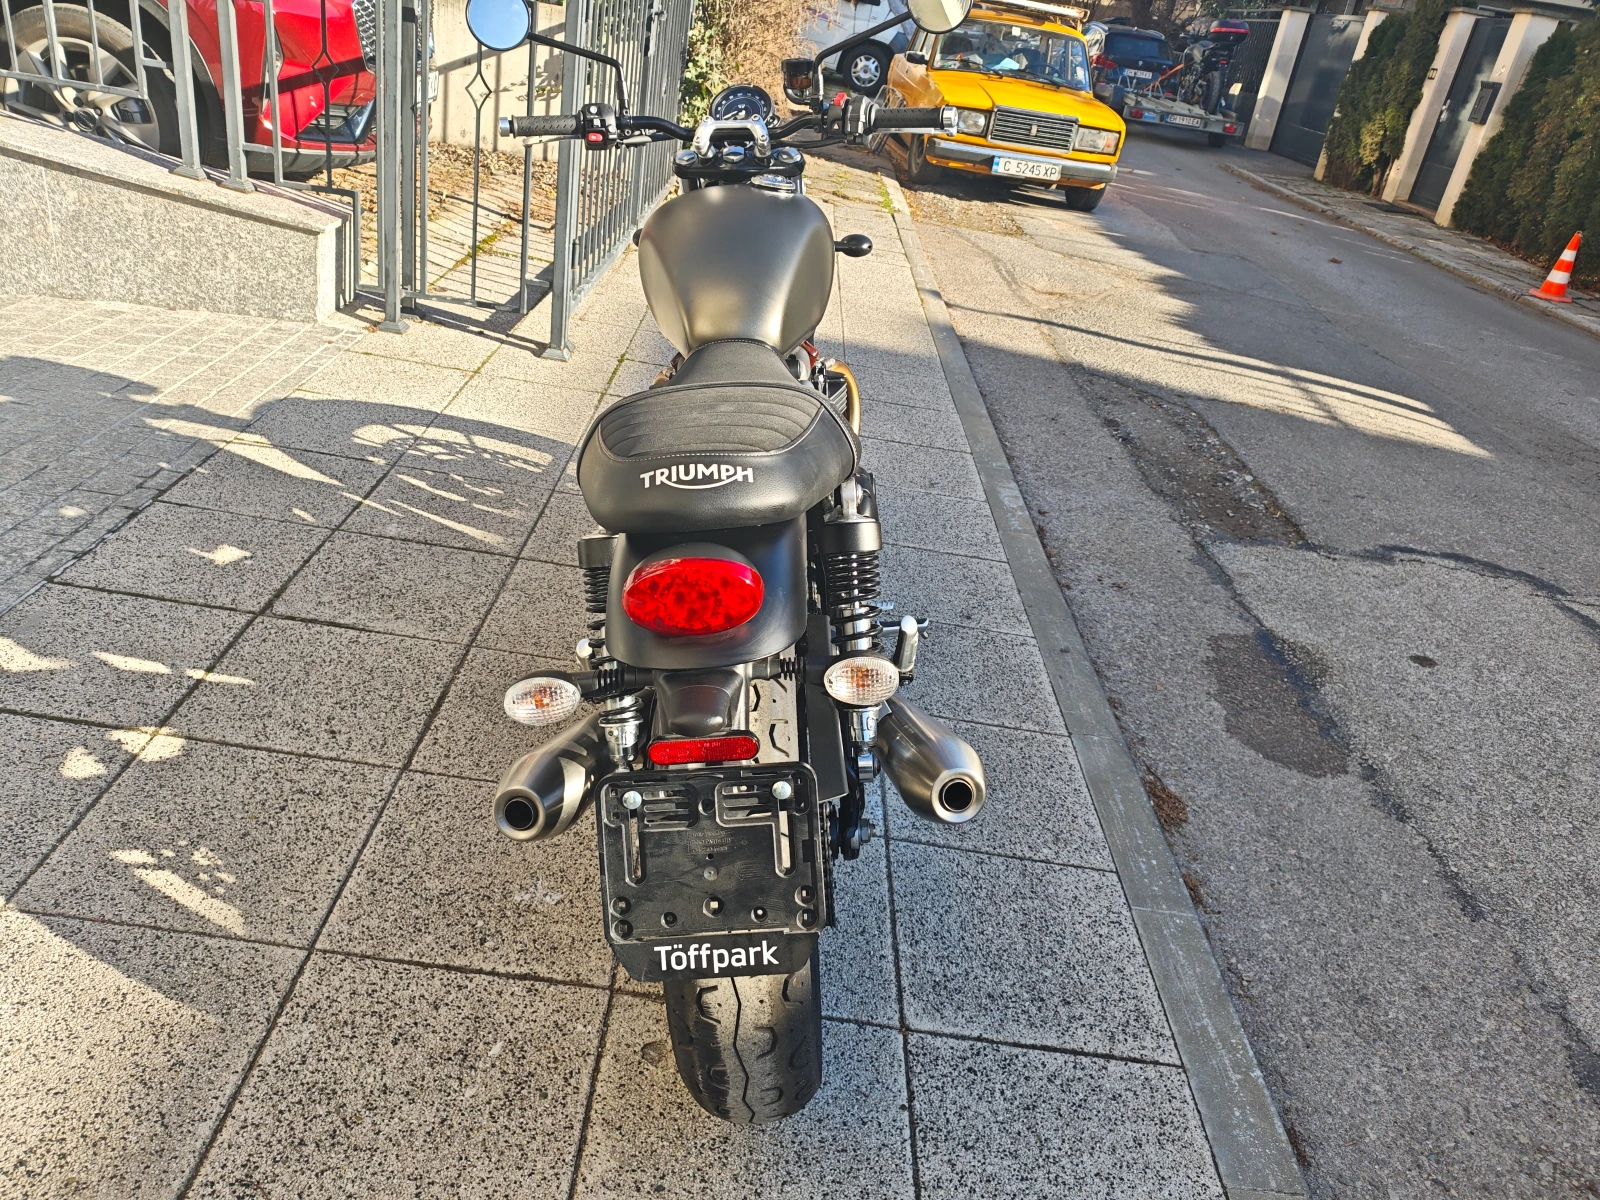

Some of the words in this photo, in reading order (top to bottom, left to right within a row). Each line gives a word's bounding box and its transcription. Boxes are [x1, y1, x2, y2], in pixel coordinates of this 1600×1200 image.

[1003, 160, 1012, 172] C
[1015, 162, 1041, 176] 5245
[1042, 166, 1057, 178] XP
[639, 463, 754, 489] TRIUMPH
[653, 940, 779, 974] Töffpark
